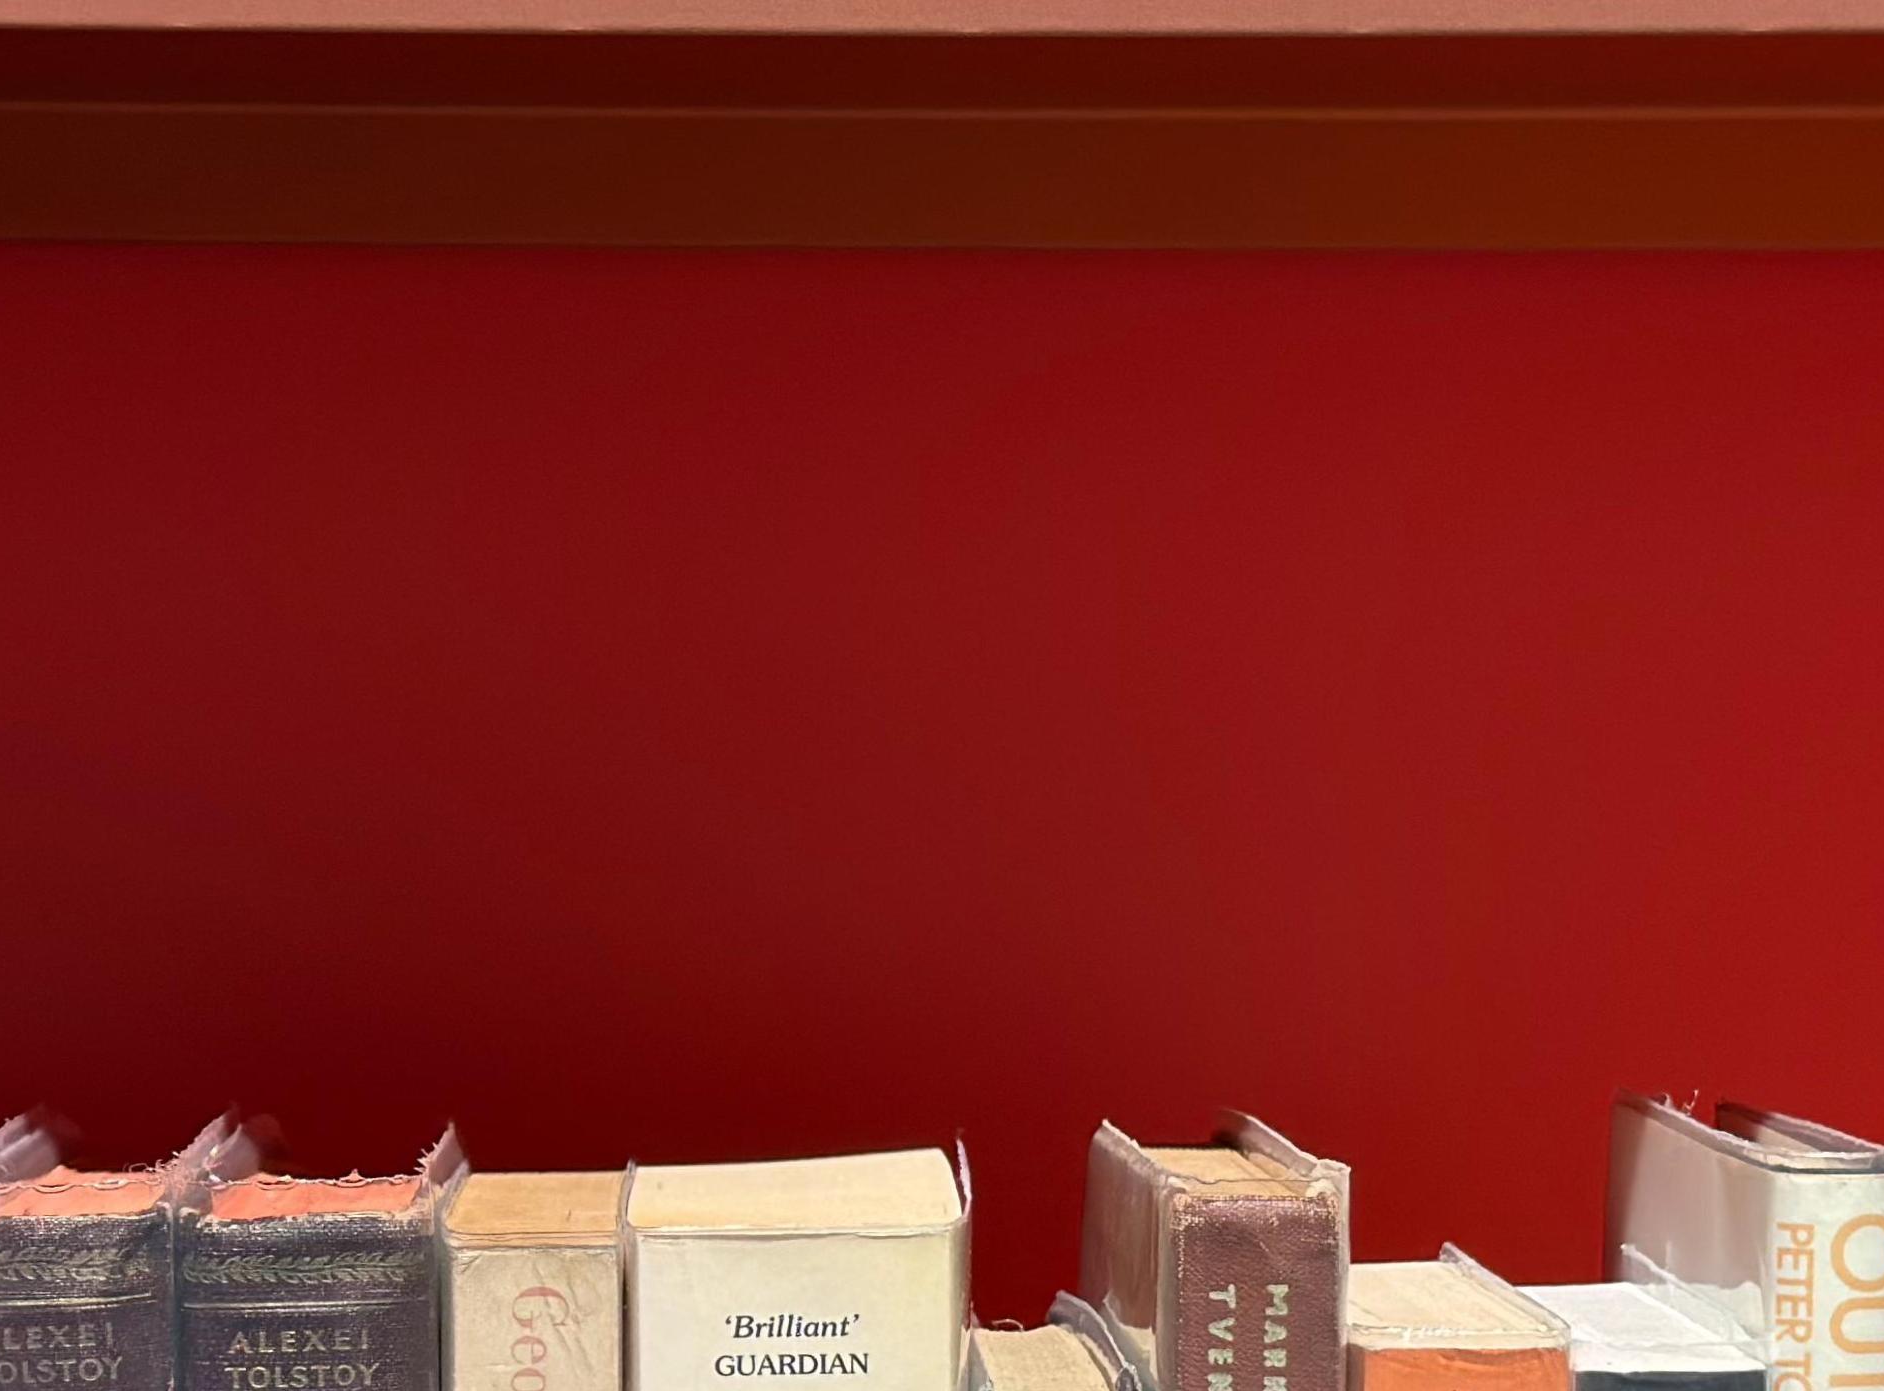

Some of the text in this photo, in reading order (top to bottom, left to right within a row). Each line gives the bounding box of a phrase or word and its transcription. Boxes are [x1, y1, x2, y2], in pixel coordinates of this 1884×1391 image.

[1774, 1221, 1815, 1344] PETER
[229, 1327, 371, 1355] ALEXEI
[224, 1362, 380, 1390] TOLSTOY
[714, 1351, 869, 1377] GUARDIAN
